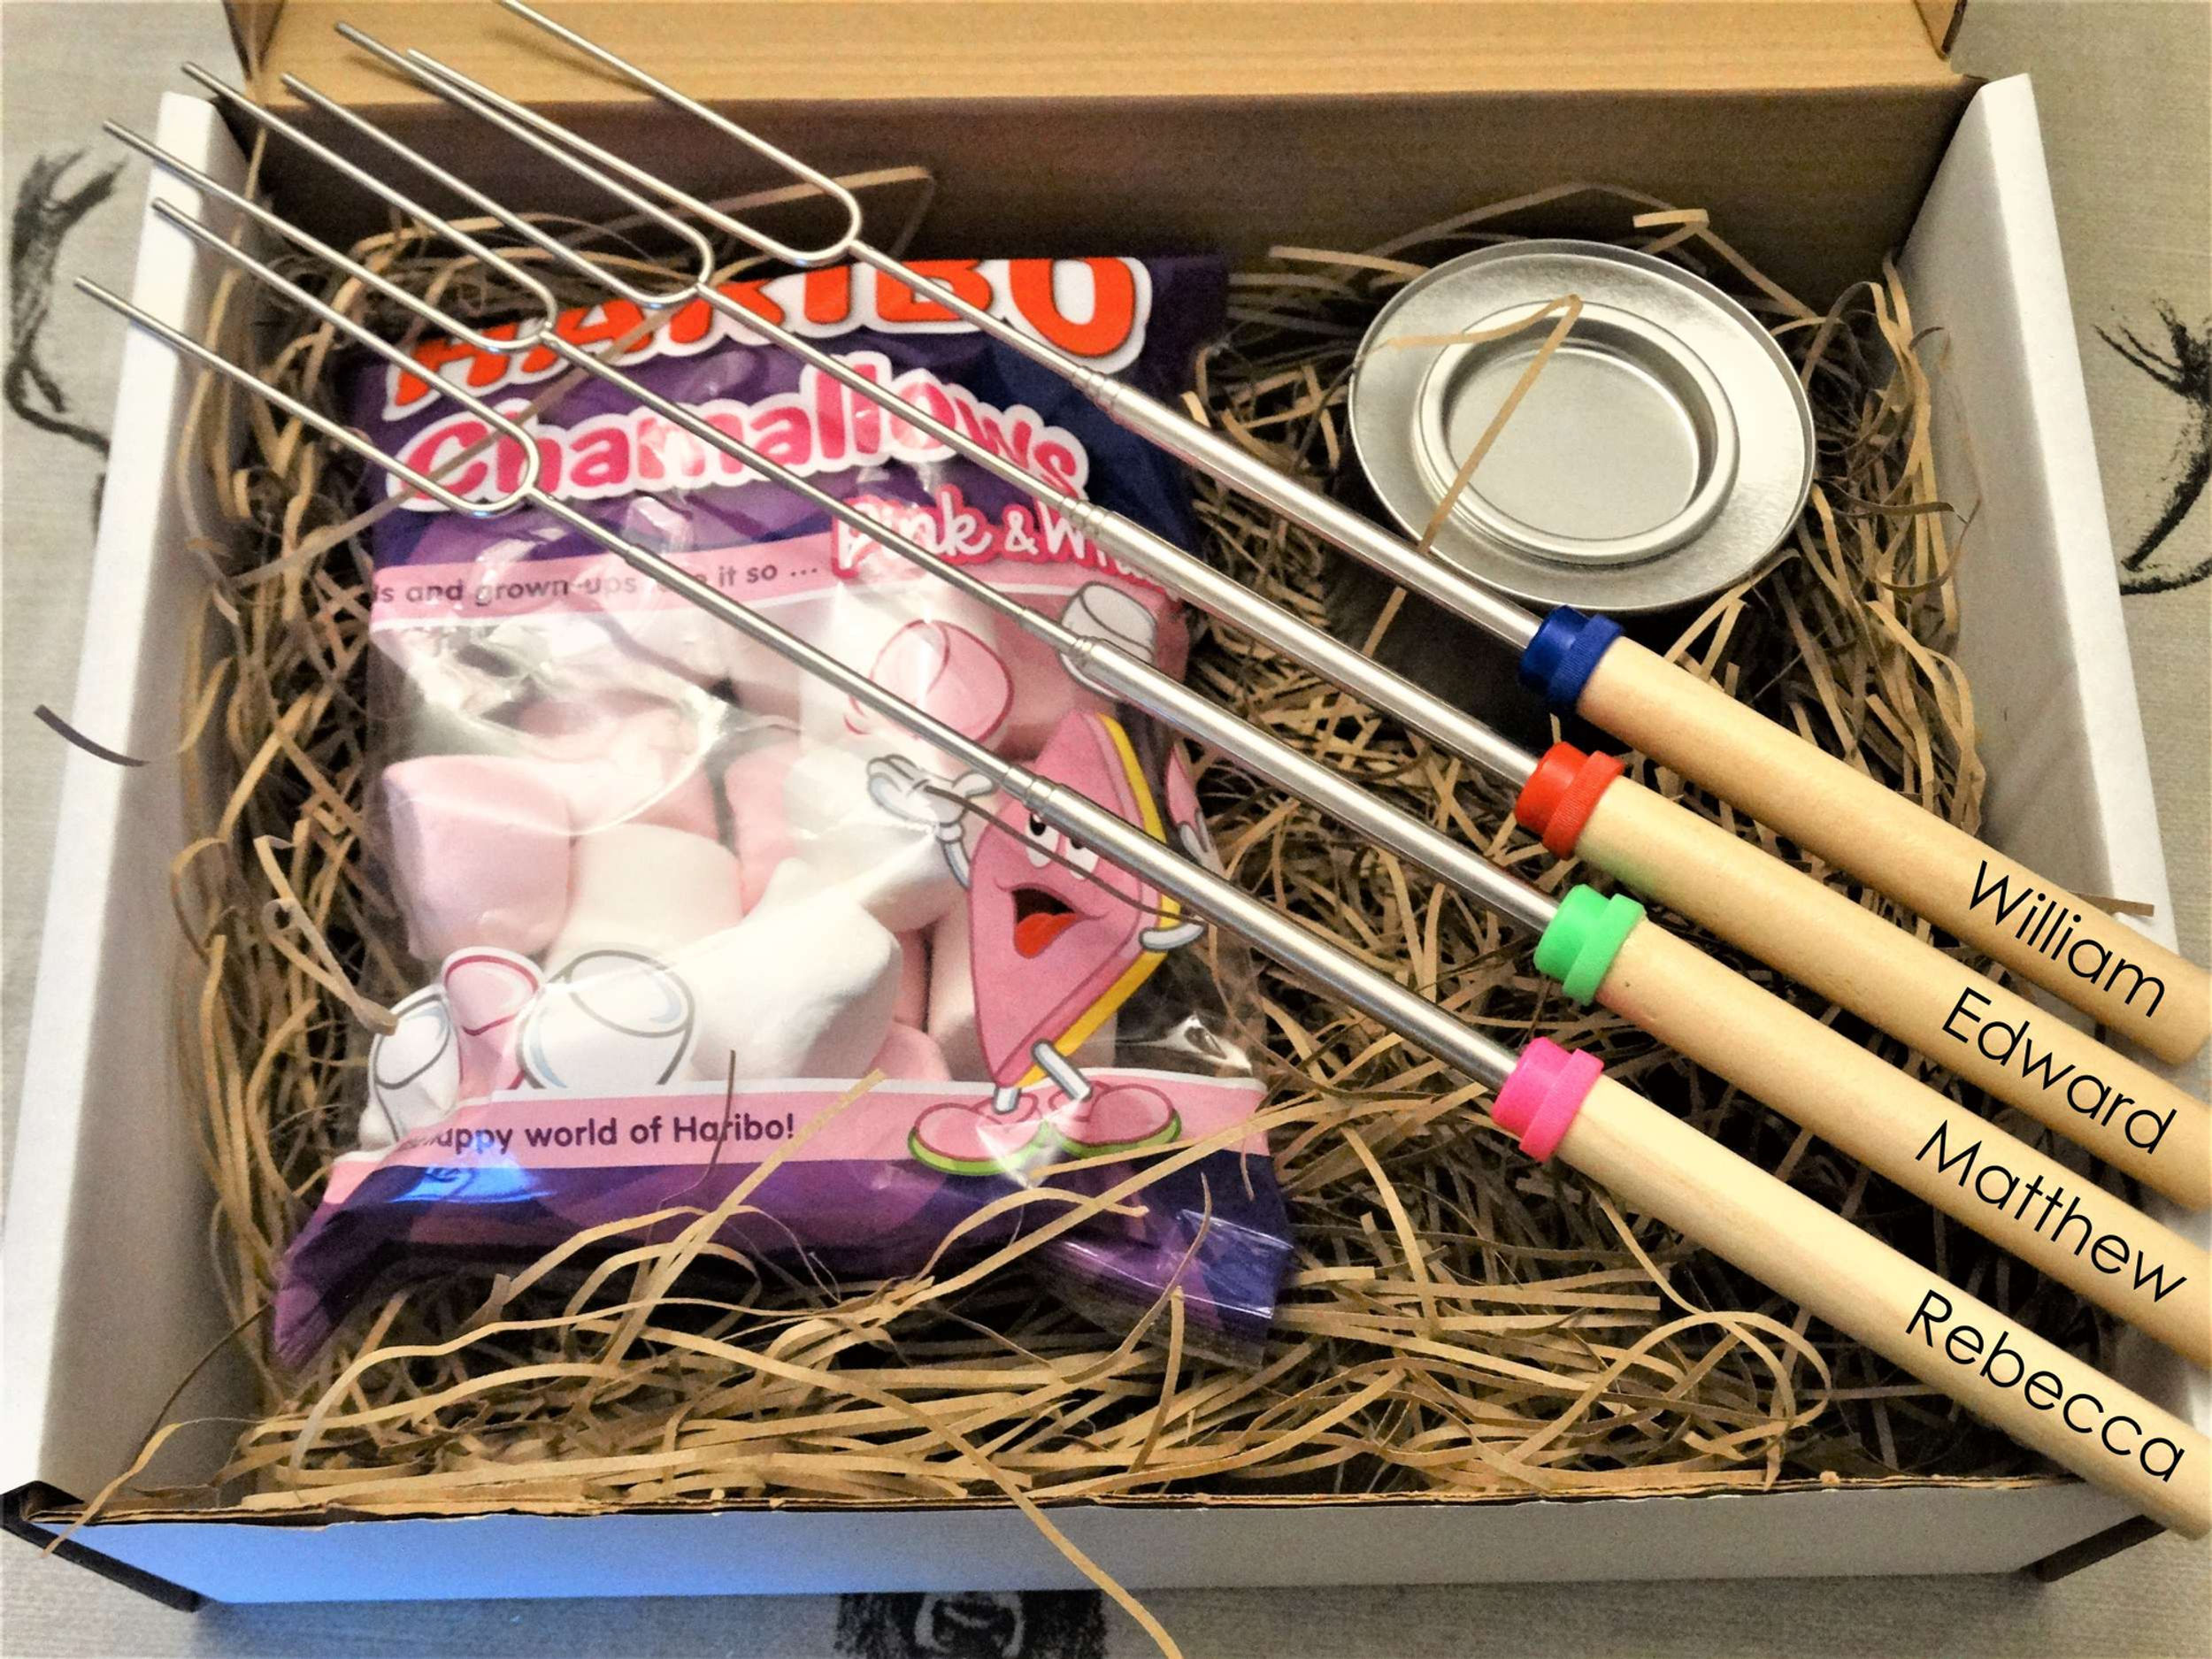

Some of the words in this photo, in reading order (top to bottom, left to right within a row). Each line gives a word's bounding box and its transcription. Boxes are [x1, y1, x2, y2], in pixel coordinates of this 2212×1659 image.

[395, 359, 1083, 503] Chamallows
[406, 579, 465, 603] and
[718, 565, 737, 588] it
[746, 563, 778, 584] so
[1004, 510, 1040, 555] &
[1969, 859, 2166, 1018] William
[426, 1126, 514, 1156] appy
[525, 1117, 617, 1148] world
[628, 1115, 663, 1144] of
[673, 1112, 795, 1144] Haribo!
[1941, 986, 2177, 1155] Edward
[1914, 1118, 2188, 1303] Matthew
[1904, 1288, 2185, 1483] Rebecca
